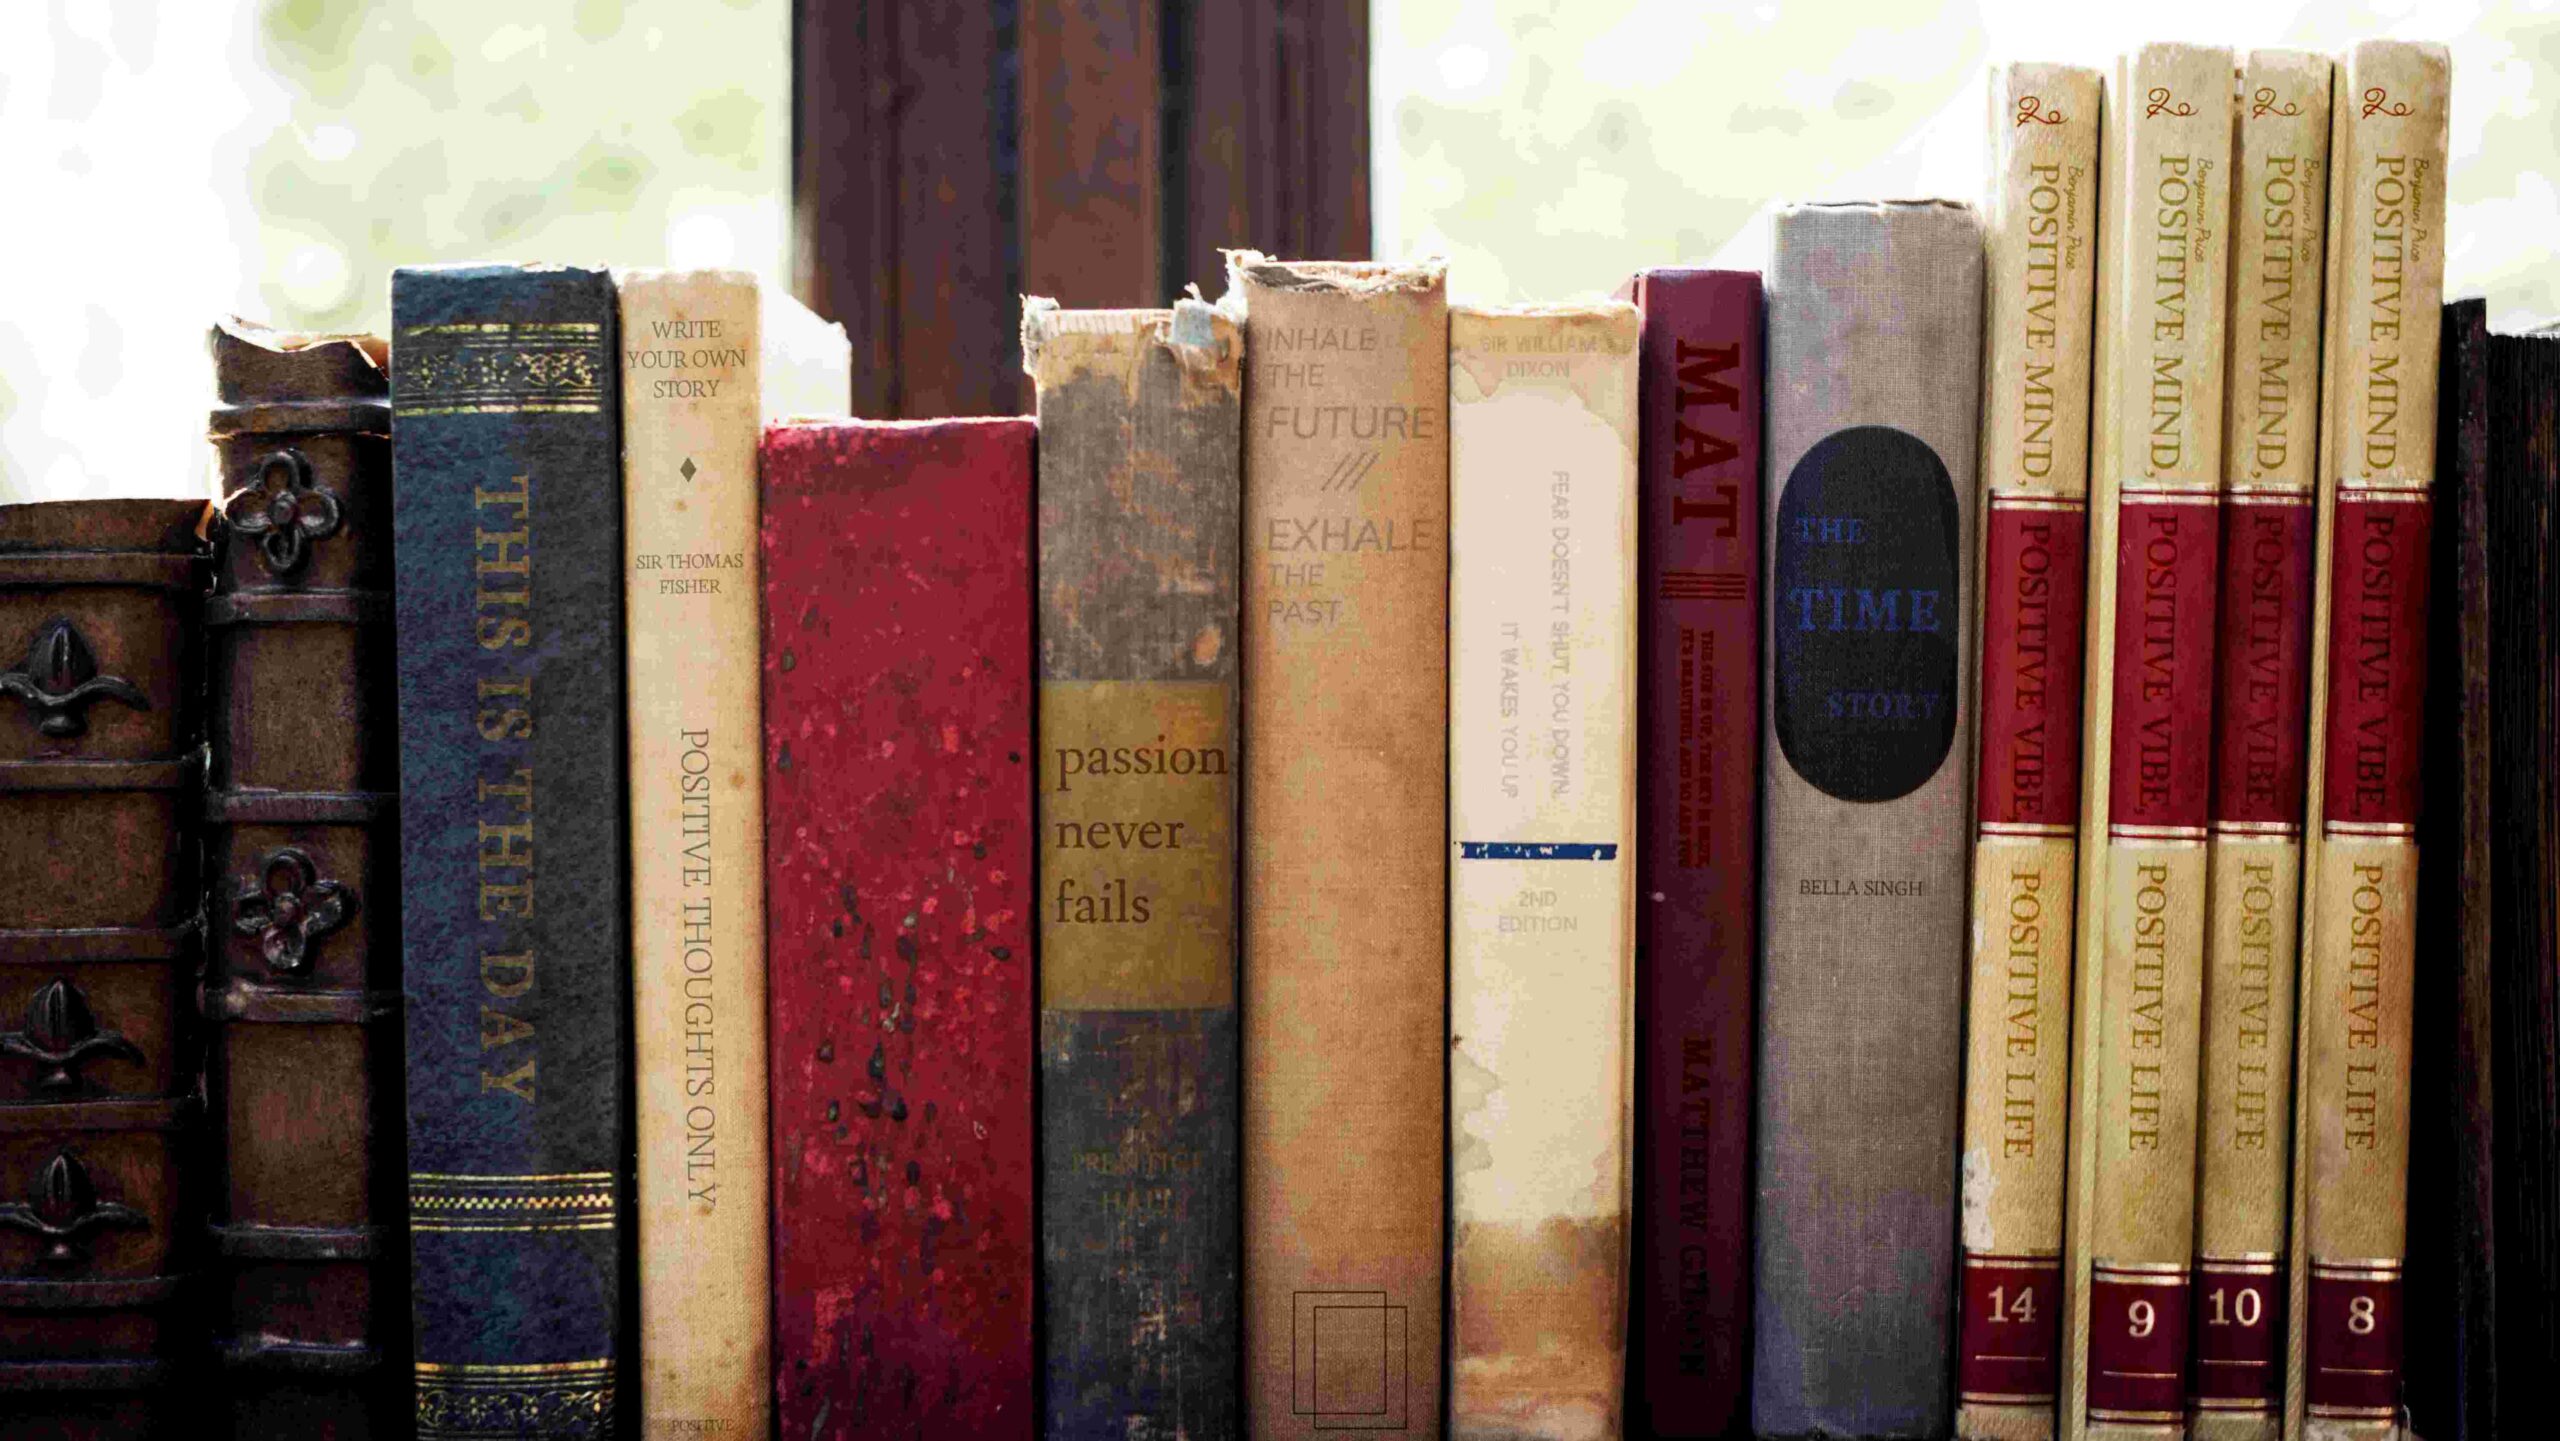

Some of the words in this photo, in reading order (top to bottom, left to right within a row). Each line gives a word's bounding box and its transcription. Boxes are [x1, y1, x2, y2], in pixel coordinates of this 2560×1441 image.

[2026, 161, 2060, 350] POSITIVE
[2155, 153, 2190, 341] POSITIVE
[2260, 153, 2297, 341] POSITIVE
[2369, 153, 2406, 341] POSITIVE
[652, 320, 722, 338] WRITE
[1266, 327, 1377, 351] INHALE
[1481, 336, 1508, 352] SIR
[1514, 335, 1599, 353] WILLIAM
[627, 350, 688, 369] YOUR
[692, 349, 747, 368] OWN
[1265, 363, 1325, 388] THE
[1507, 359, 1571, 378] DIXON
[653, 379, 720, 399] STORY
[2144, 353, 2184, 479] MIND,
[2250, 354, 2288, 479] MIND,
[2359, 354, 2399, 479] MIND,
[1267, 406, 1435, 440] FUTURE
[1673, 338, 1740, 538] MAT
[2016, 360, 2054, 487] MIND,
[1551, 470, 1570, 520] FEAR
[1267, 517, 1434, 551] EXHALE
[1794, 516, 1866, 544] THE
[475, 475, 531, 651] THIS
[636, 555, 663, 570] SIR
[667, 554, 744, 569] THOMAS
[659, 579, 722, 595] FISHER
[1268, 563, 1325, 587] THE
[1551, 527, 1570, 614] DOESN'T
[1267, 600, 1343, 623] PAST
[1501, 621, 1519, 641] IT
[1790, 586, 1941, 632] TIME
[2014, 521, 2050, 711] POSITIVE
[2142, 512, 2179, 703] POSITIVE
[2250, 512, 2285, 703] POSITIVE
[2359, 511, 2395, 703] POSITIVE
[1551, 621, 1570, 674] SHUT
[476, 676, 532, 743] IS
[1501, 648, 1519, 719] WAKES
[1551, 681, 1570, 723] YOU
[1827, 689, 1940, 719] STORY
[1055, 733, 1229, 792] passion
[1501, 724, 1519, 766] YOU
[681, 728, 712, 886] POSITIVE
[1501, 774, 1519, 800] UP
[478, 768, 534, 922] THE
[1055, 820, 1185, 850] never
[1055, 878, 1150, 924] fails
[1518, 891, 1557, 907] 2ND
[1800, 879, 1859, 896] BELLA
[1863, 879, 1923, 897] SINGH
[1498, 915, 1578, 932] EDITION
[2007, 871, 2041, 1058] POSITIVE
[2132, 863, 2168, 1050] POSITIVE
[2238, 863, 2274, 1050] POSITIVE
[2348, 862, 2383, 1050] POSITIVE
[480, 949, 535, 1101] DAY
[683, 897, 715, 1097] THOUGHTS
[2004, 1069, 2036, 1159] LIFE
[2129, 1063, 2161, 1150] LIFE
[2235, 1063, 2268, 1150] LIFE
[2345, 1063, 2377, 1150] LIFE
[686, 1105, 716, 1206] ONLY
[1680, 1037, 1711, 1233] MATTHEW
[1987, 1286, 2037, 1323] 14
[2127, 1300, 2155, 1338] 9
[2208, 1287, 2262, 1327] 10
[2348, 1296, 2376, 1335] 8
[671, 1419, 735, 1432] POSITIVE
